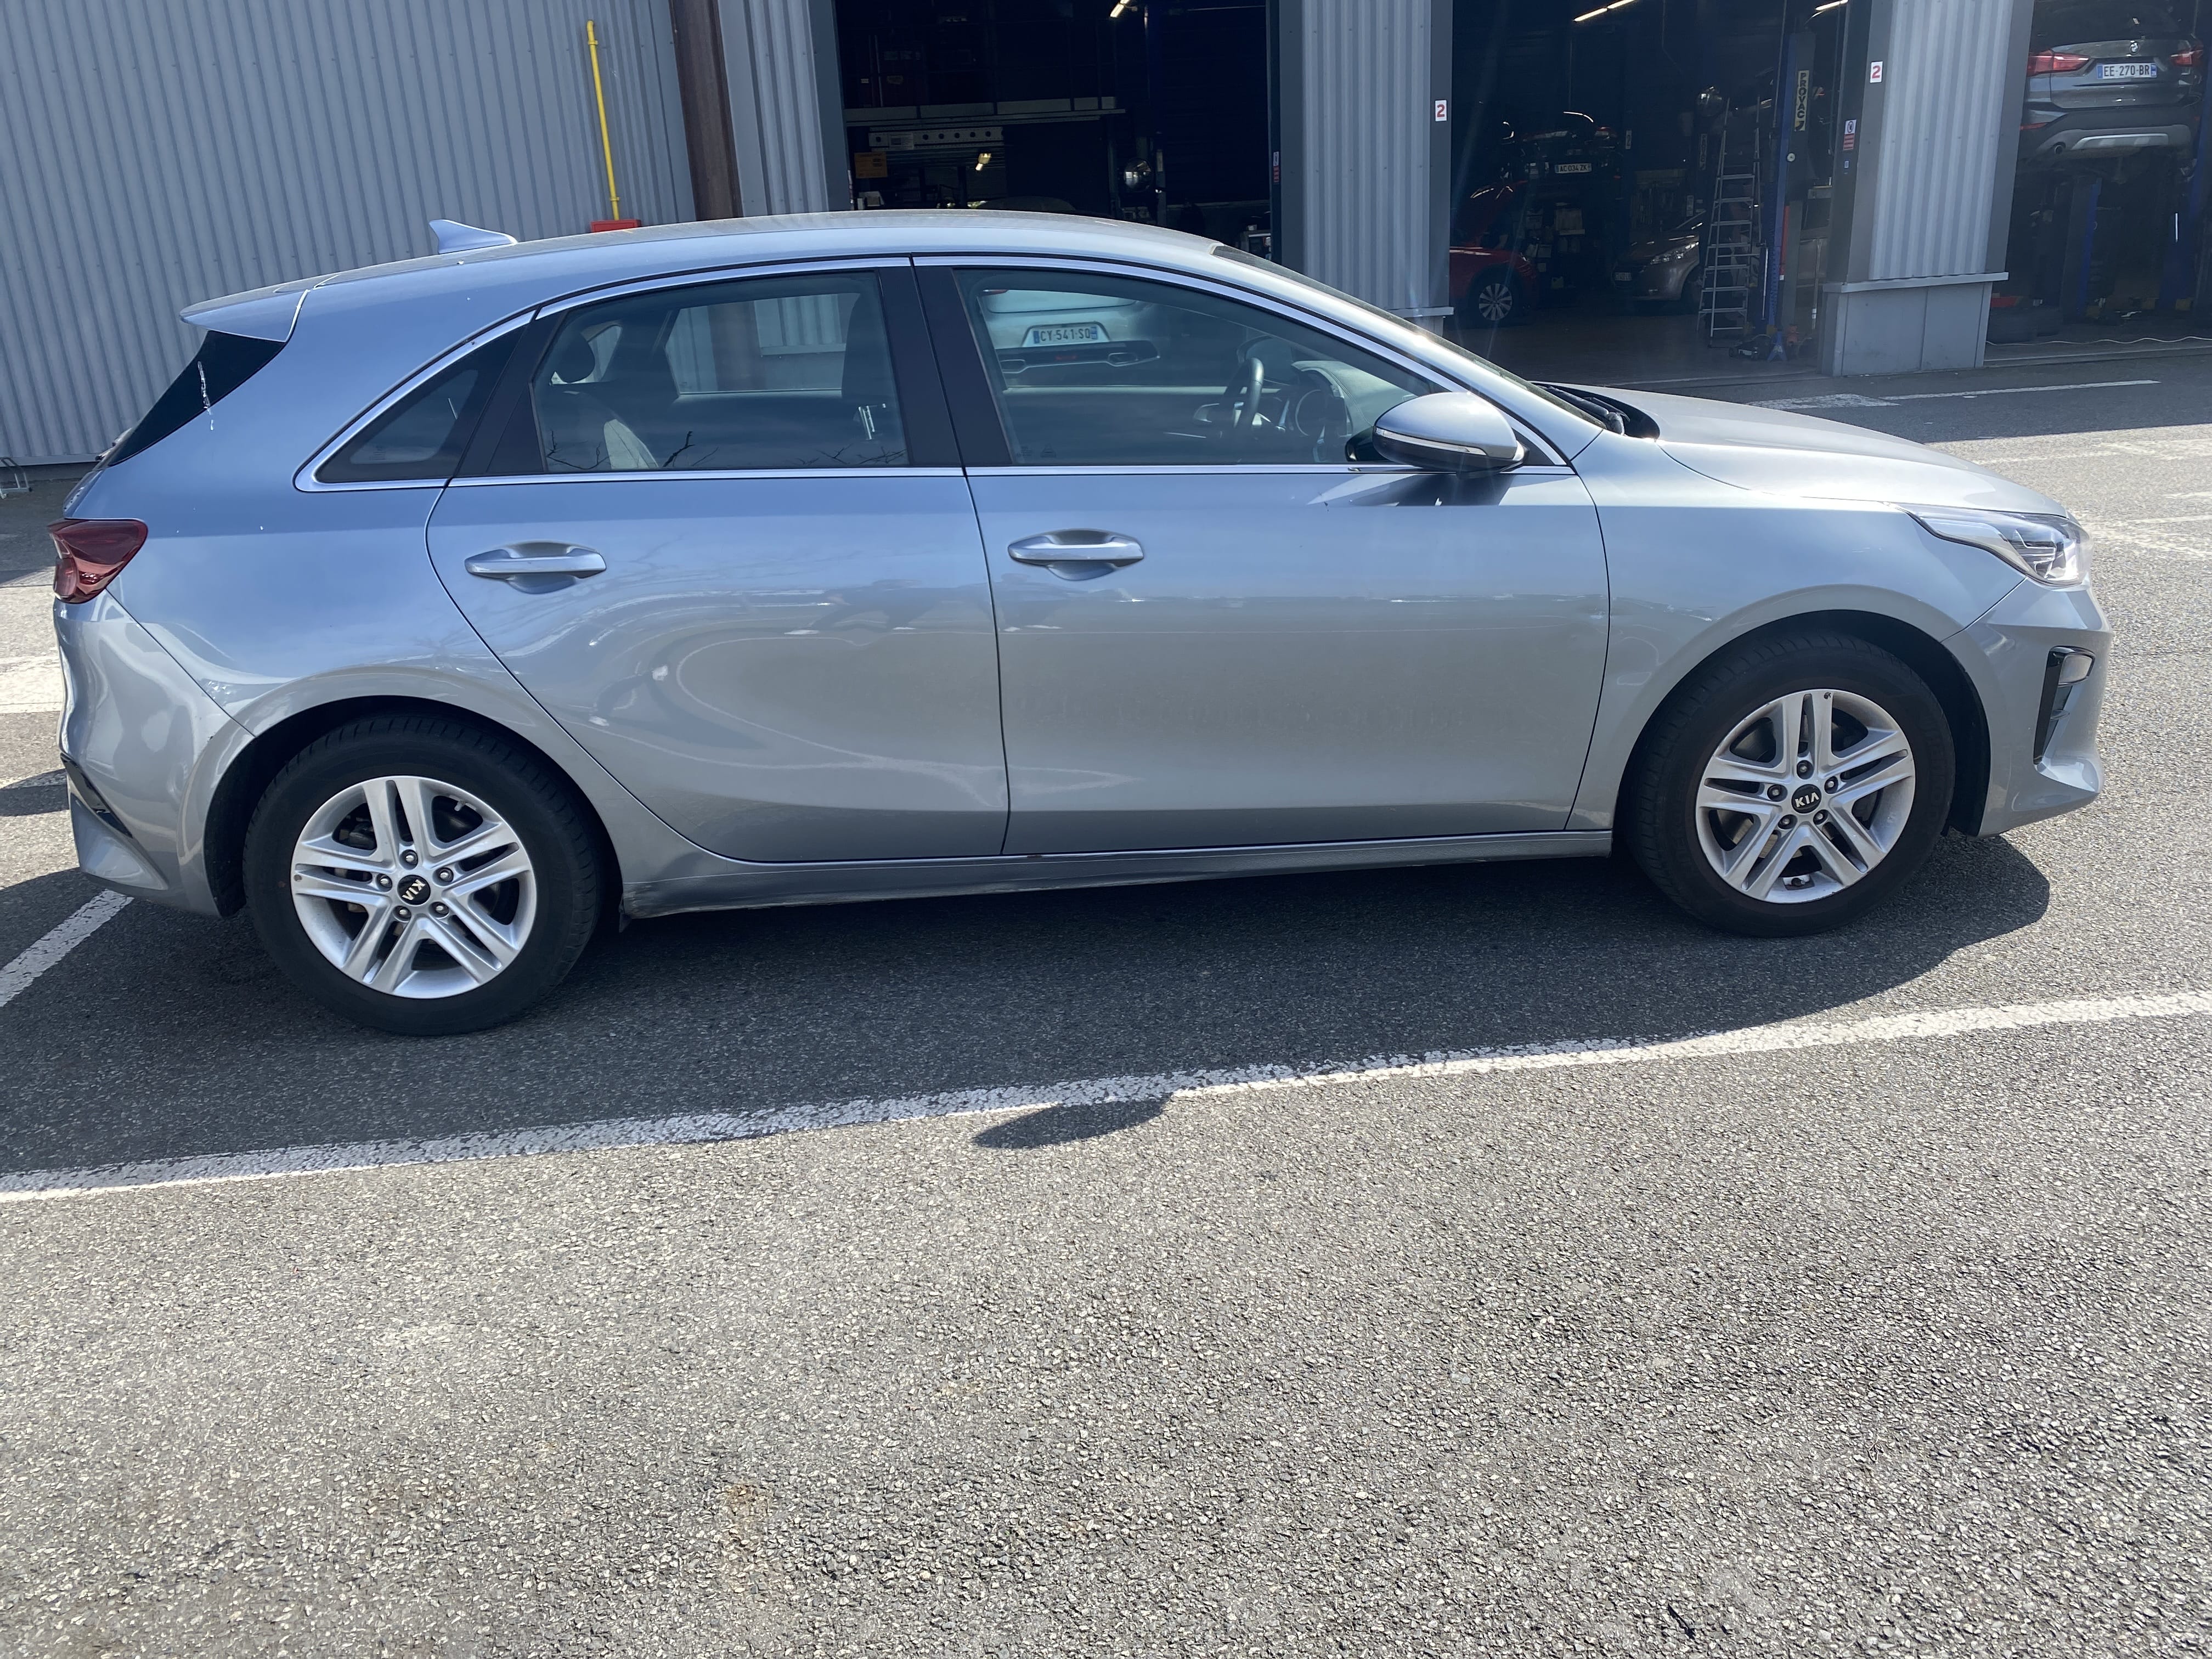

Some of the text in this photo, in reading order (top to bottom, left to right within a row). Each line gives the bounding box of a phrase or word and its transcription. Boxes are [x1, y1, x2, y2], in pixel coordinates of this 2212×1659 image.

[1872, 65, 1881, 78] 2
[2104, 65, 2149, 77] EE-270-BR
[1797, 72, 1807, 119] PROVAC
[1437, 104, 1445, 117] 2
[1795, 792, 1819, 808] KIA
[402, 879, 426, 900] KIA
